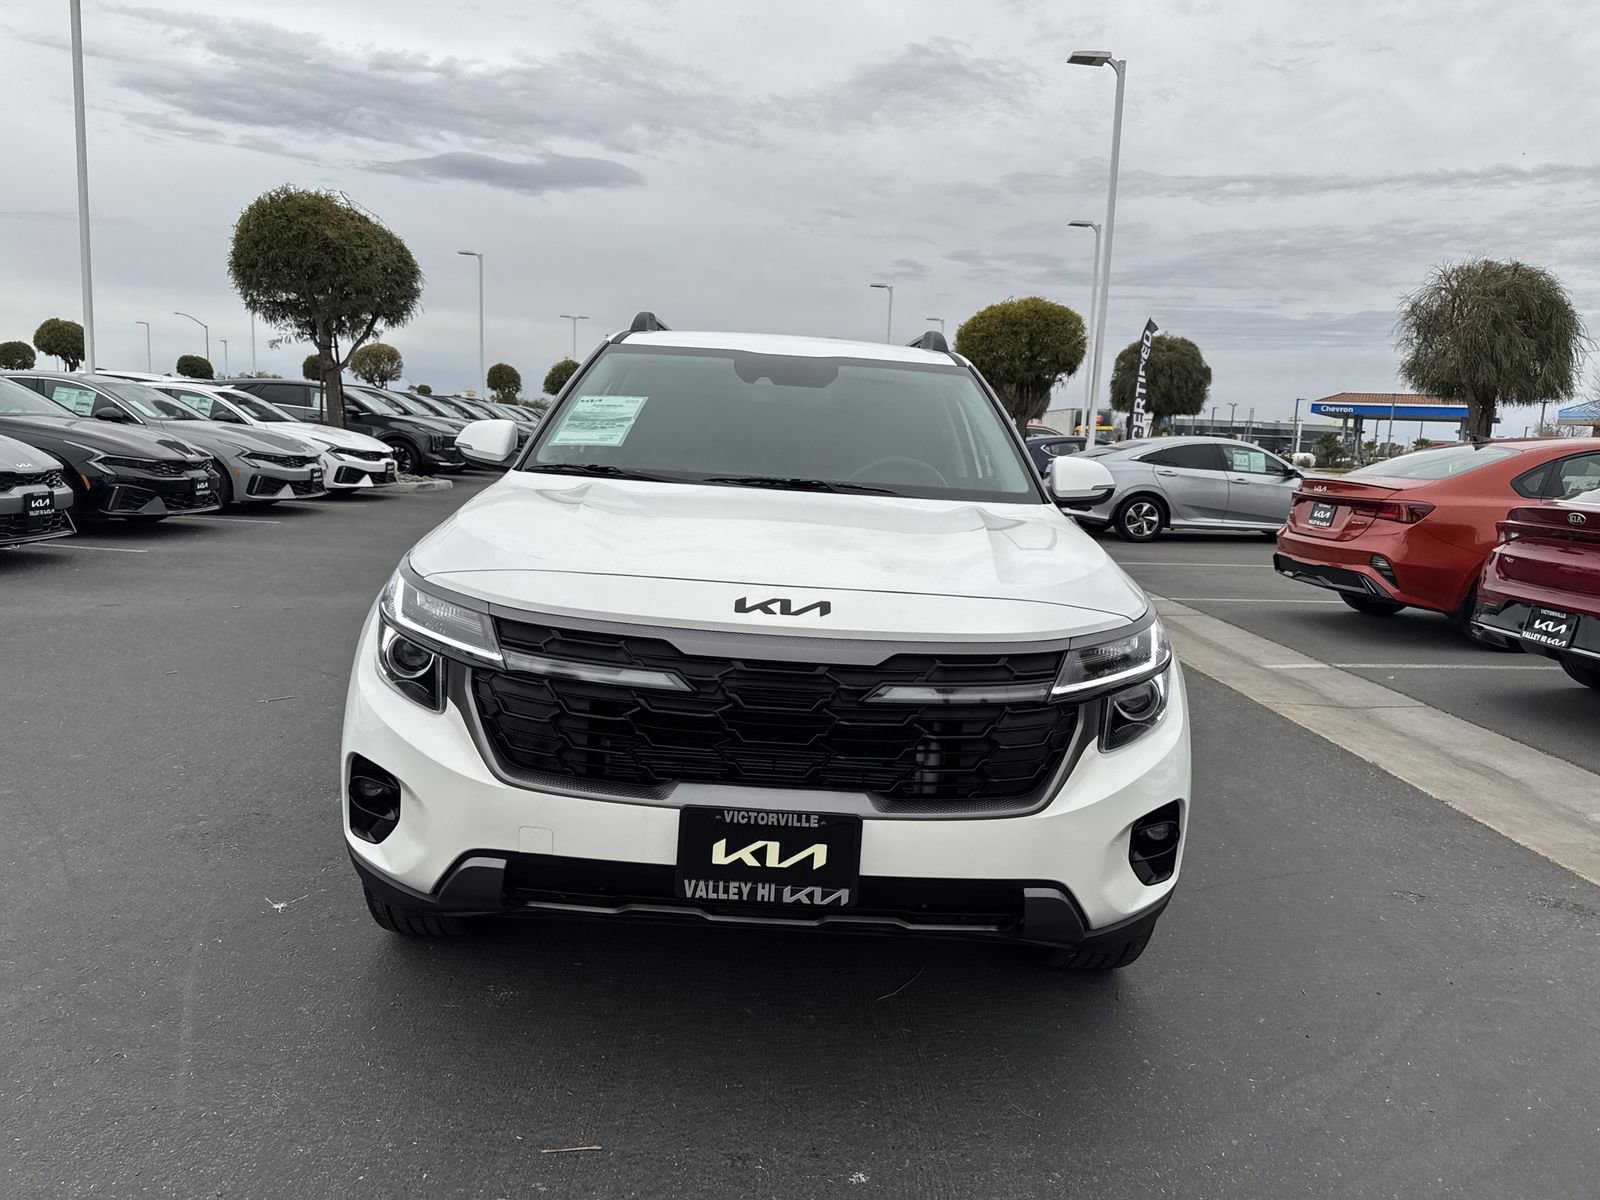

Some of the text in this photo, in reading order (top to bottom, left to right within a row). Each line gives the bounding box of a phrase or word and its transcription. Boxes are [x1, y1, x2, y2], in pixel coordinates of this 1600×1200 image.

[1320, 405, 1354, 413] Chevron
[31, 498, 50, 508] KIA
[1568, 515, 1583, 523] KIA
[734, 596, 831, 617] KIA
[1534, 619, 1566, 634] KIA
[1522, 630, 1542, 641] VALLEY
[1547, 638, 1566, 647] KIA
[723, 810, 819, 828] VICTORVILLE
[711, 838, 828, 871] KIA
[684, 879, 850, 907] VALLEY HI KIA
